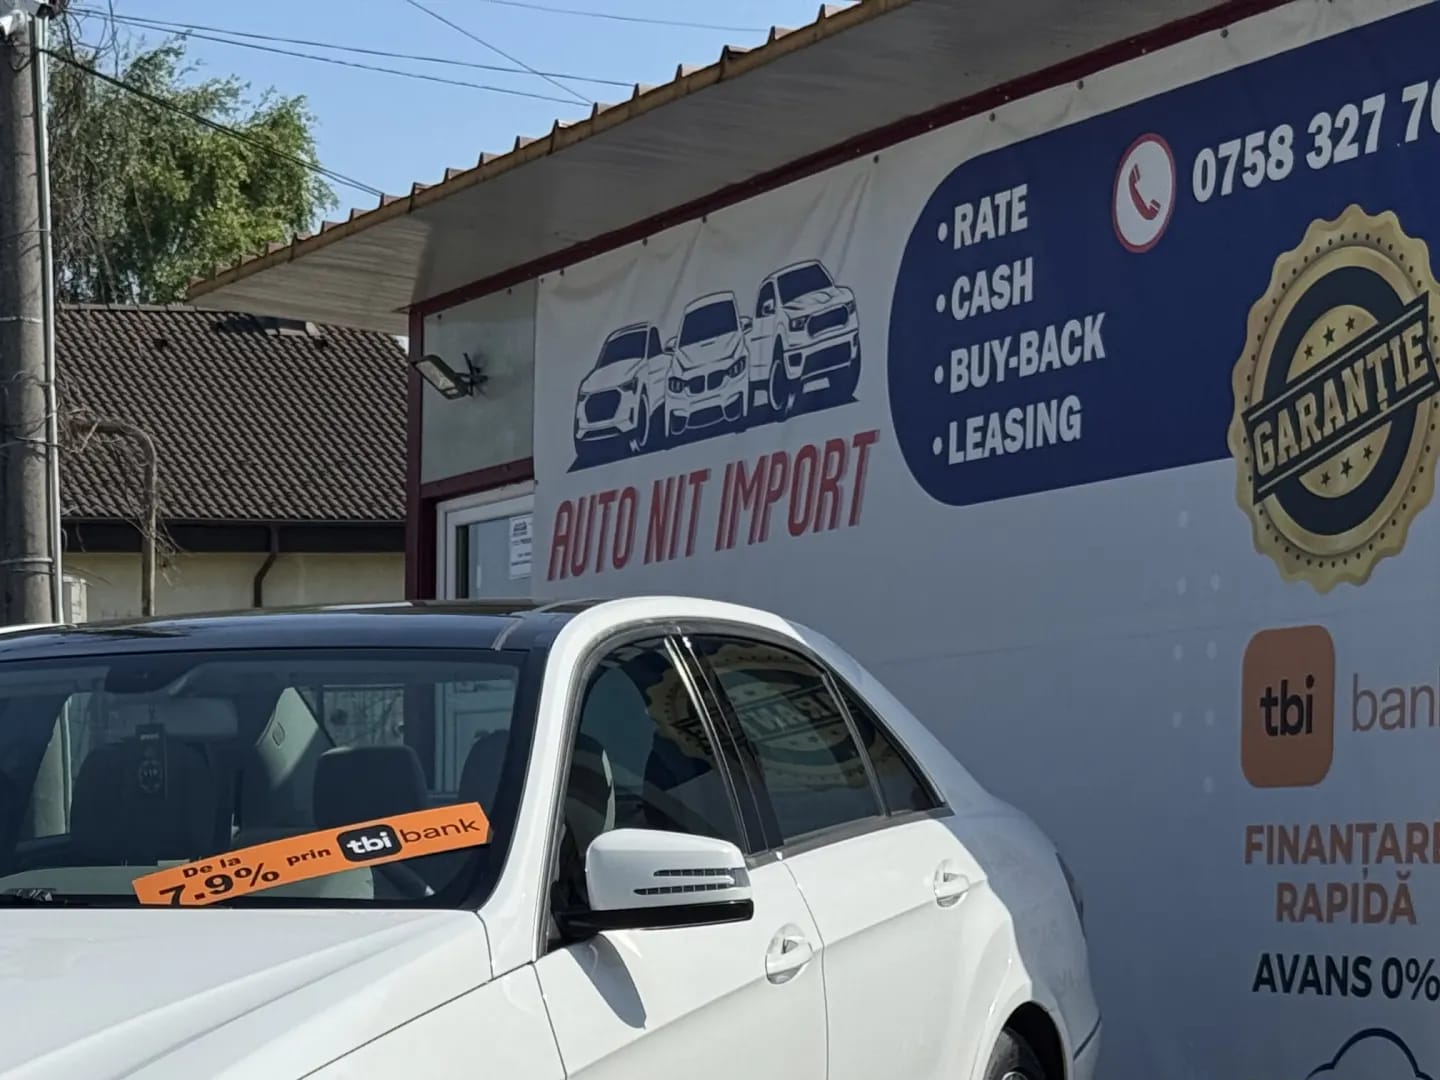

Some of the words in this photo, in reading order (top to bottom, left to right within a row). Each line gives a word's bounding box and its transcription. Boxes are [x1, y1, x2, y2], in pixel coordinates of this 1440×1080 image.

[1193, 124, 1294, 202] 0758
[1306, 93, 1386, 169] 327
[954, 184, 1028, 250] RATE
[951, 257, 1033, 320] CASH
[950, 312, 1106, 393] BUY-BACK
[948, 395, 1082, 465] LEASING
[547, 486, 639, 581] AUTO
[643, 468, 711, 565] NIT
[715, 429, 880, 552] IMPORT
[1260, 674, 1315, 737] tbi
[1352, 666, 1440, 732] ban
[182, 865, 213, 878] De
[220, 857, 241, 868] la
[286, 847, 332, 867] prin
[347, 831, 392, 854] tbi
[399, 818, 482, 843] bank
[159, 863, 280, 905] 7.9%
[1276, 870, 1417, 925] RAPIDĂ
[1252, 953, 1372, 998] AVANS
[1381, 957, 1440, 1002] 0%
